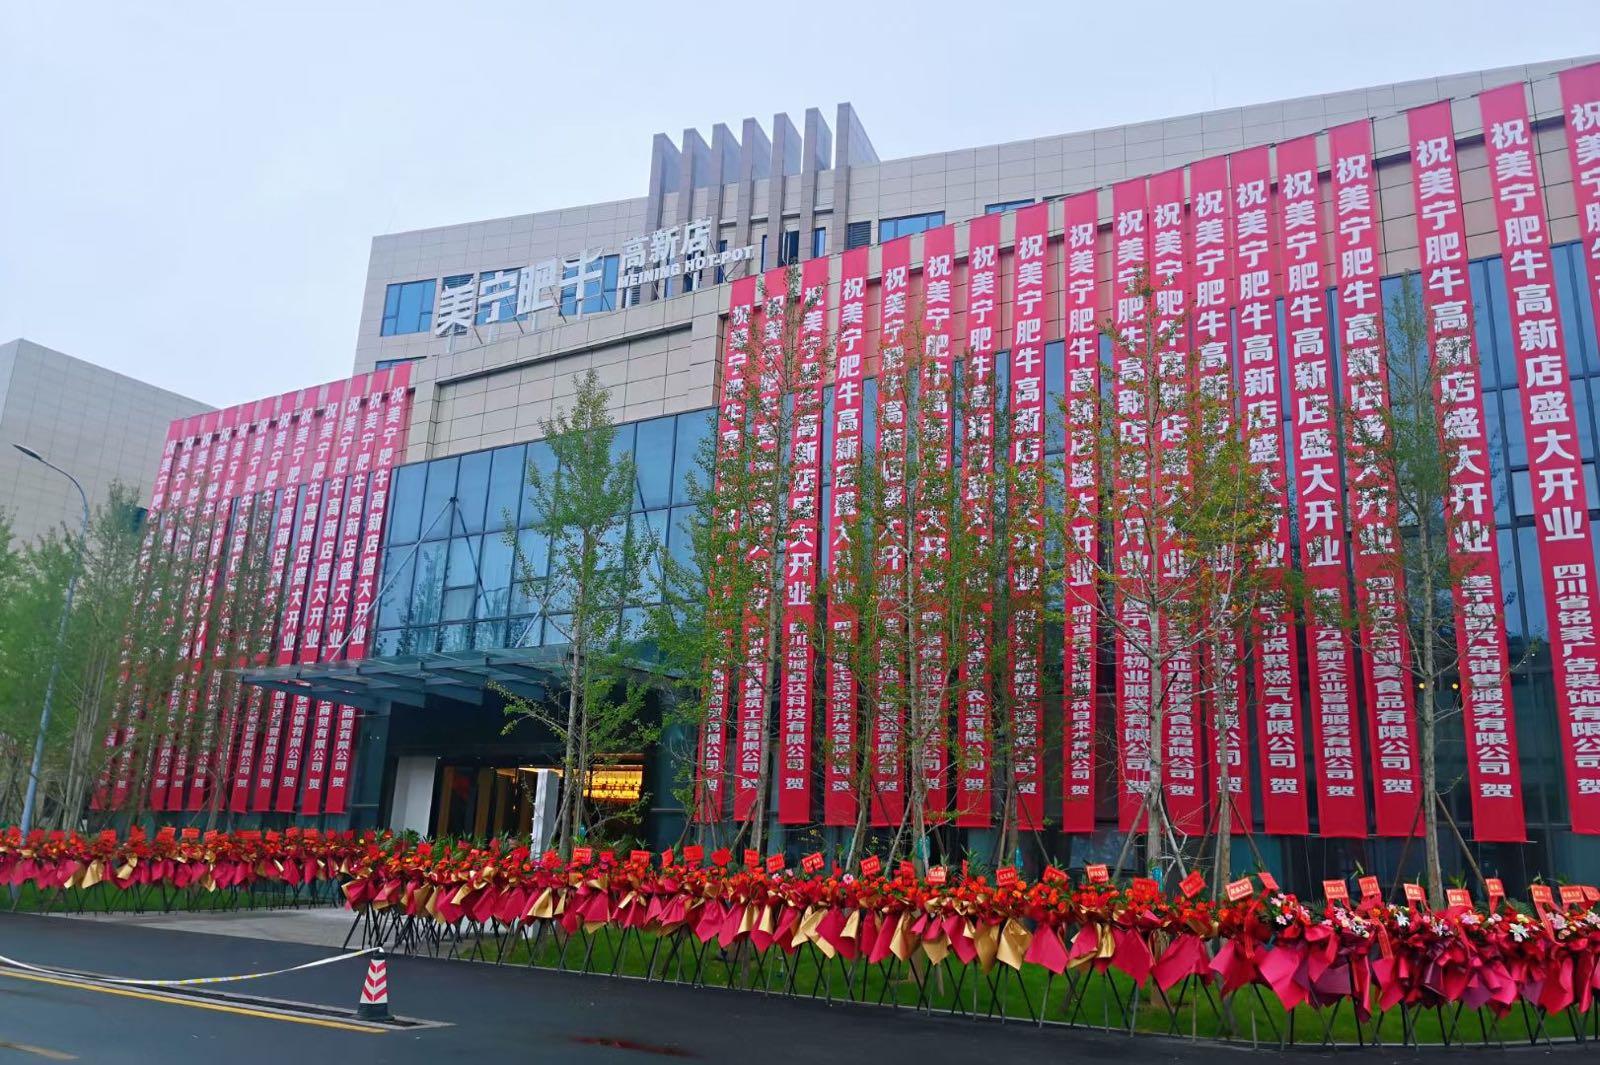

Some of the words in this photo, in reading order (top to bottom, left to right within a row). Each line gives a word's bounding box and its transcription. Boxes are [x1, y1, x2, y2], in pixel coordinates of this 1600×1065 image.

[435, 249, 604, 337] 美宁肥牛
[622, 217, 712, 268] 高新店
[1283, 170, 1341, 567] 祝美宁肥牛高新店盛大开业
[1491, 119, 1585, 542] 祝美宁肥牛高新店盛大开业
[305, 396, 360, 648] 祝美宁肥牛高新店盛大开业
[328, 392, 382, 649] 祝美宁肥牛高新店盛大开业
[351, 386, 405, 645] 祝美宁肥牛高新店盛大开业
[1417, 137, 1492, 553] 祝美宁肥牛高新店盛大开业
[1480, 783, 1514, 798] 贺
[335, 704, 354, 771] 商贸有限公司
[1270, 778, 1298, 794] 贺
[1382, 779, 1414, 794] 贺
